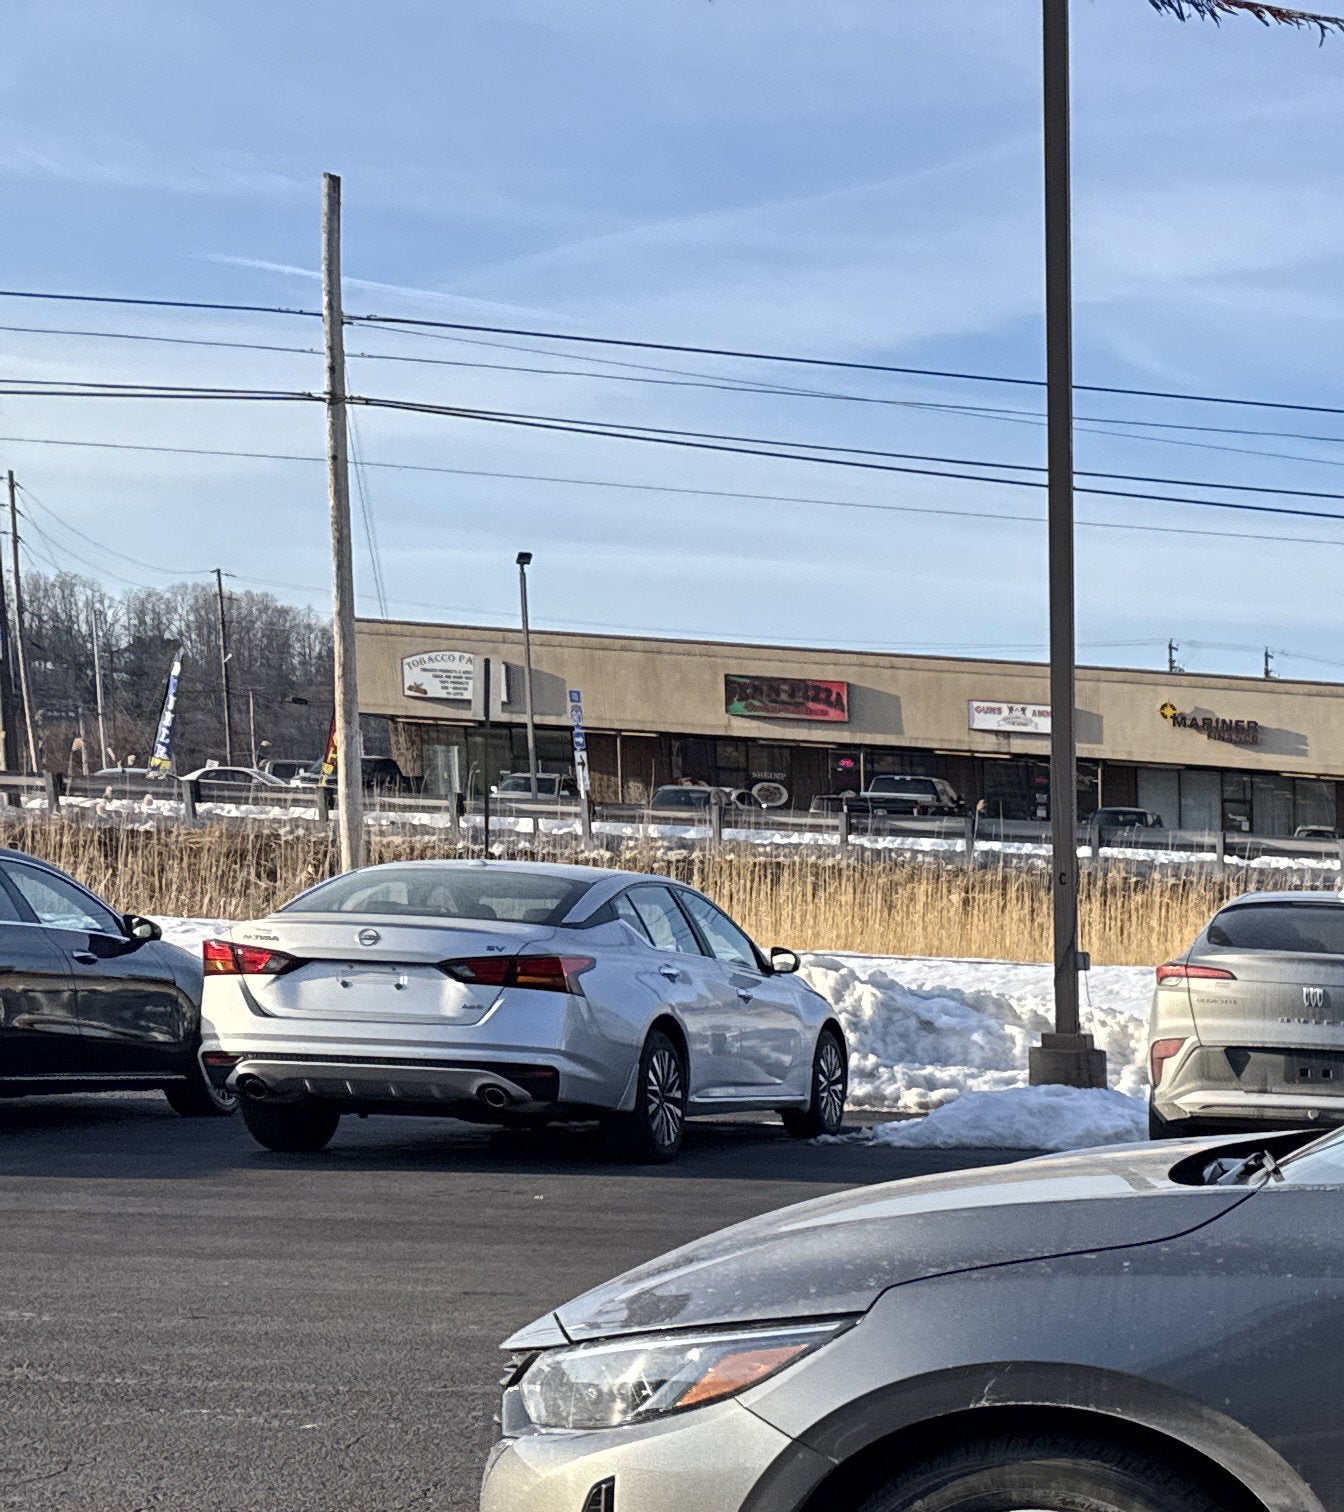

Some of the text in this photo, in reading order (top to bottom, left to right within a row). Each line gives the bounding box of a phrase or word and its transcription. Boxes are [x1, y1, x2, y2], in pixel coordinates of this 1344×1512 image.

[405, 654, 456, 671] TOBACCO
[974, 705, 1003, 716] GUNS
[1172, 715, 1260, 732] MARINER
